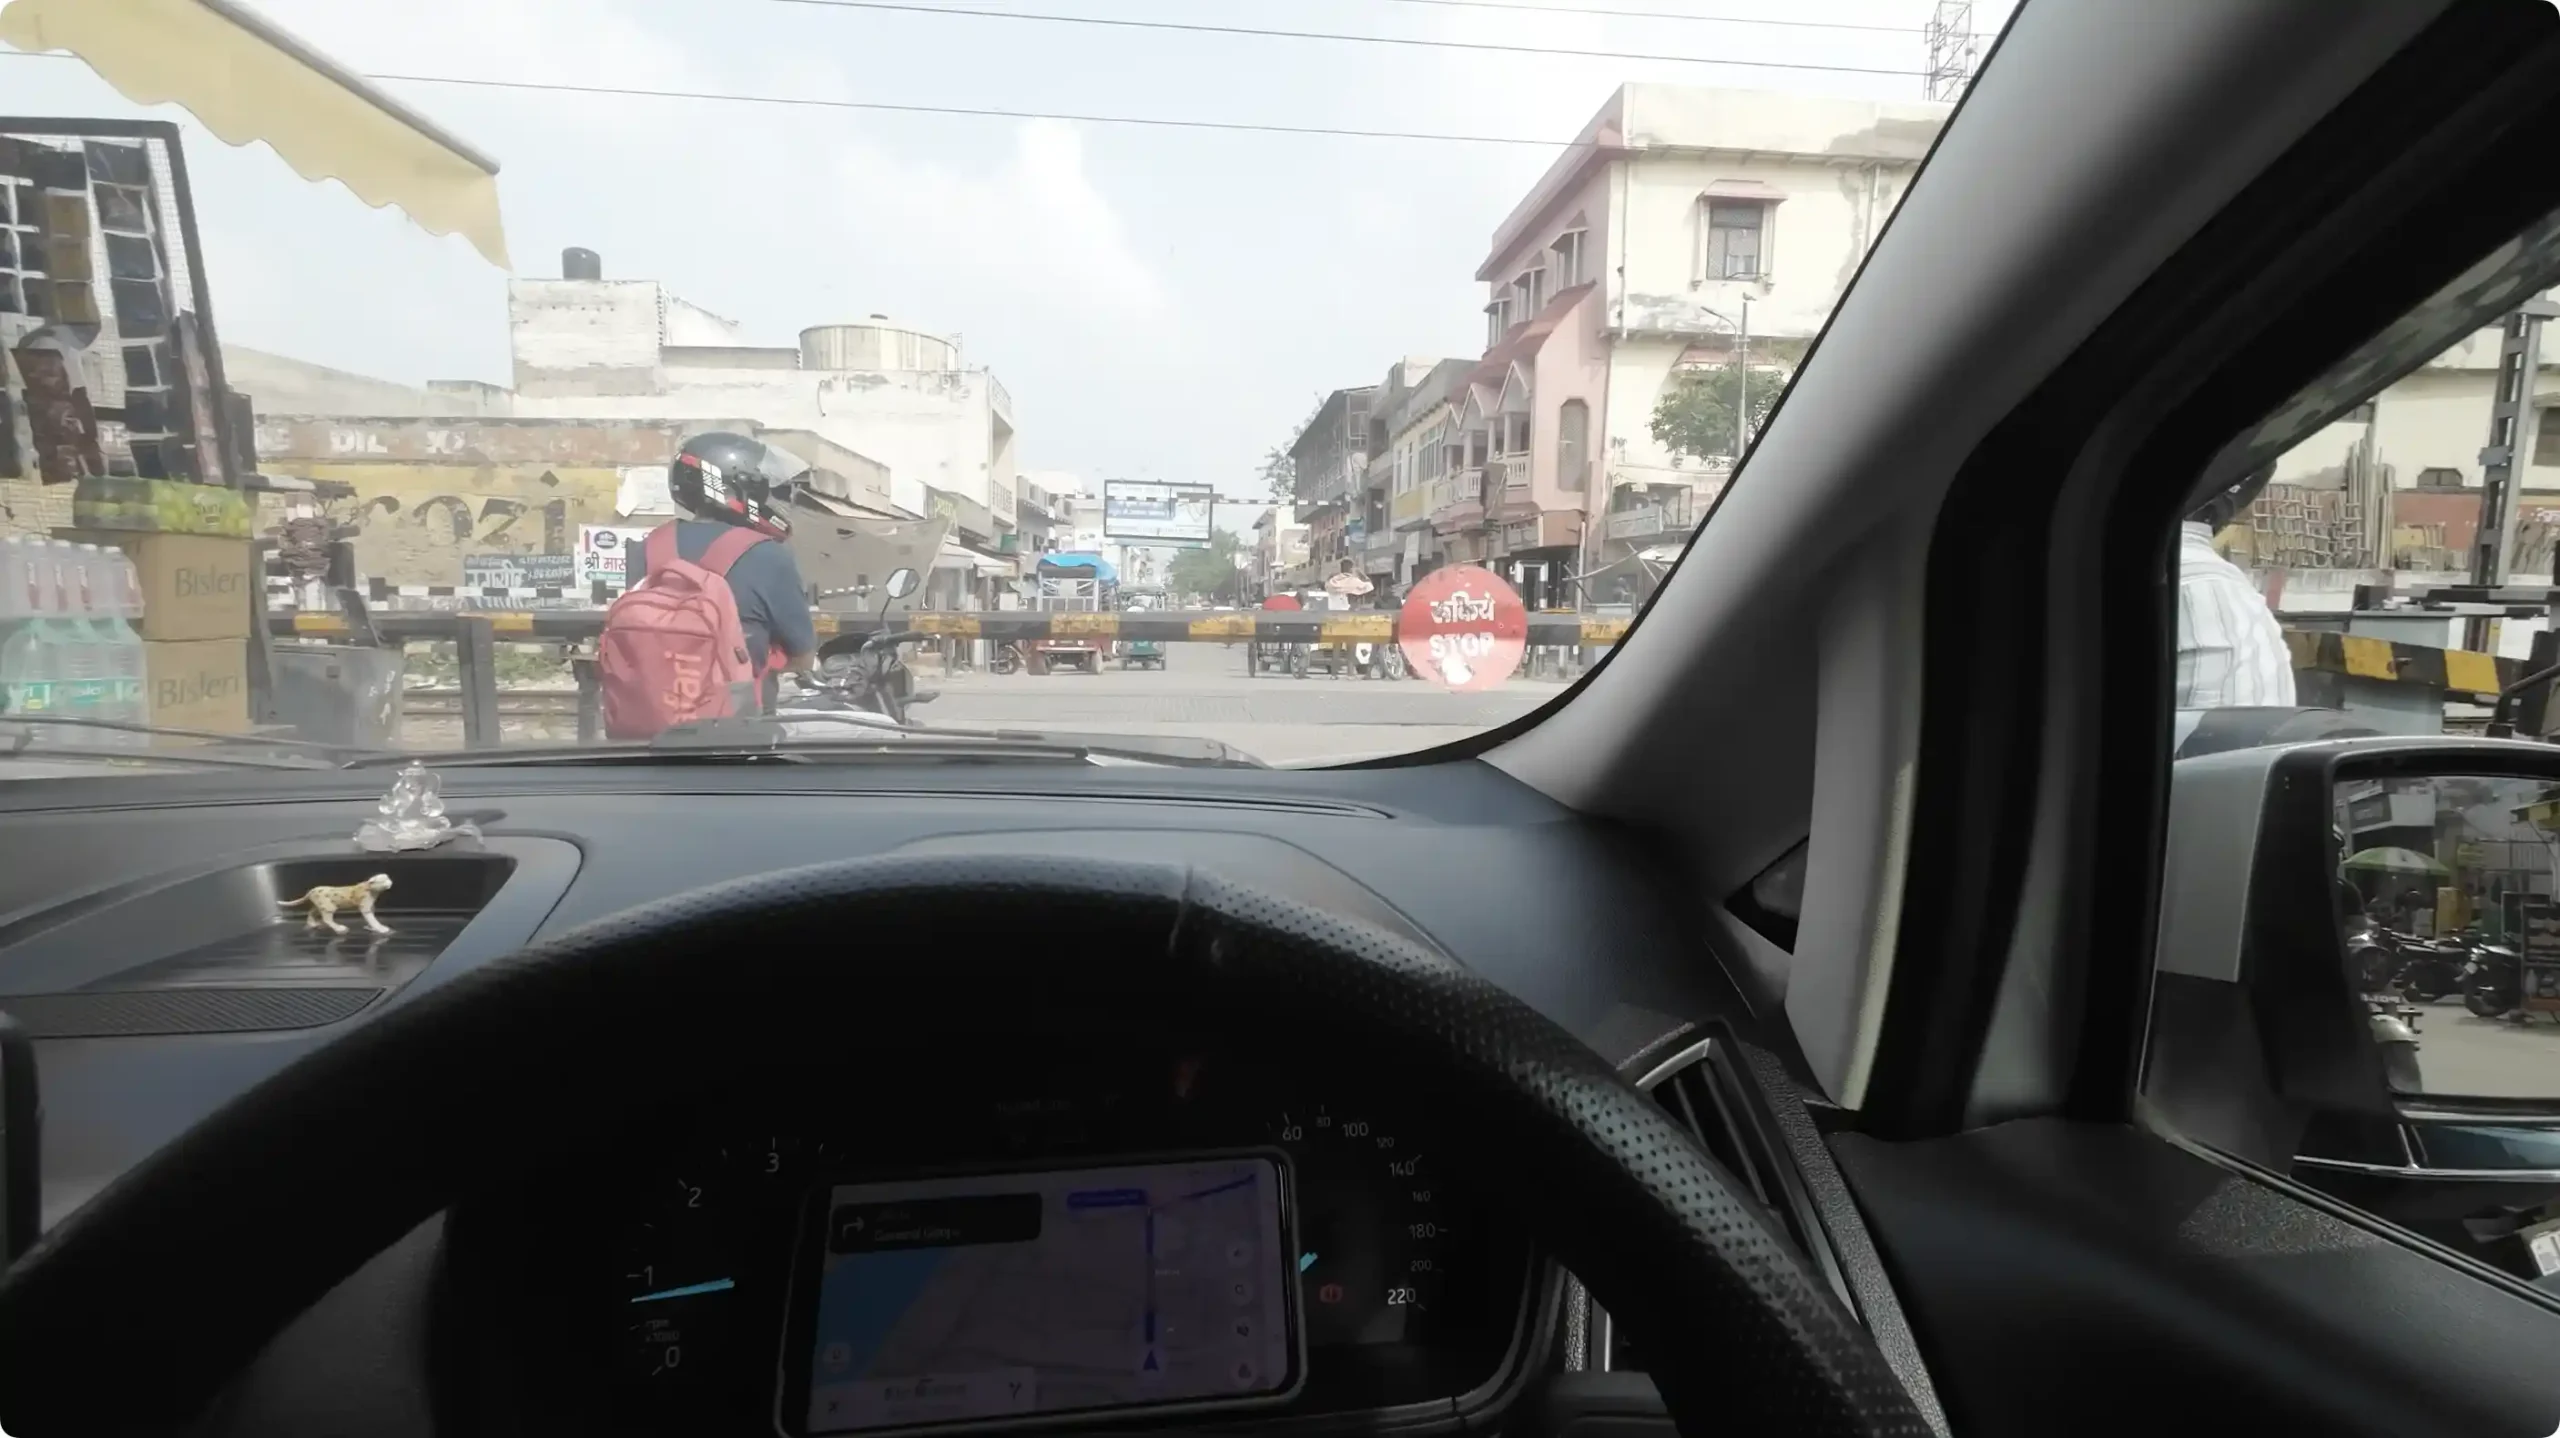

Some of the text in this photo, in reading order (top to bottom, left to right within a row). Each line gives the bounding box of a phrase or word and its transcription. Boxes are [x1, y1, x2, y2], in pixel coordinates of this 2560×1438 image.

[1429, 632, 1495, 659] STOP
[157, 670, 241, 710] Bisleri
[1282, 1125, 1302, 1141] 60
[1342, 1121, 1369, 1137] 100
[764, 1152, 780, 1173] 3
[1389, 1160, 1415, 1177] 140
[687, 1187, 702, 1208] 2
[1408, 1222, 1436, 1239] 180
[1410, 1259, 1432, 1272] 200
[643, 1264, 654, 1287] 1
[1387, 1287, 1416, 1305] 220
[665, 1345, 681, 1368] 0
